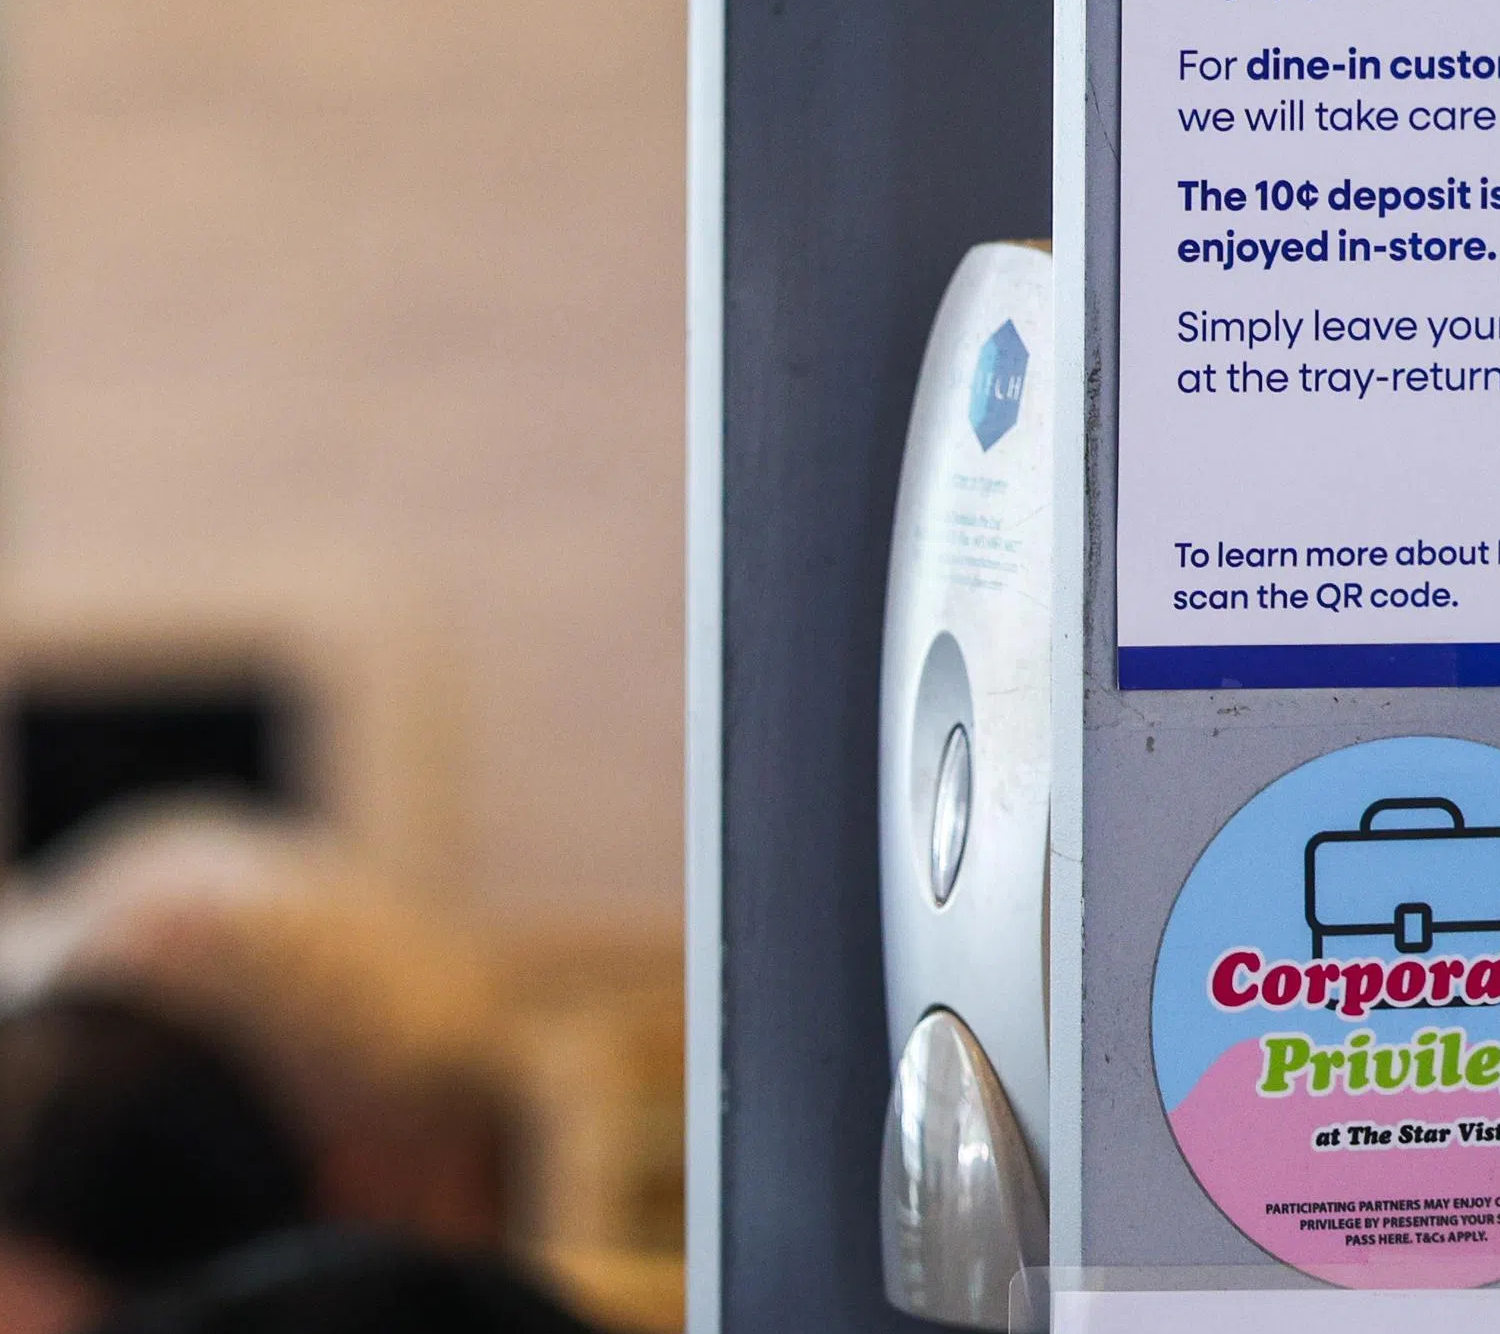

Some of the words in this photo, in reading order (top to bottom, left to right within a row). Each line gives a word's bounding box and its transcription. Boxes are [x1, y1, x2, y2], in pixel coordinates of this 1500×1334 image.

[1180, 50, 1237, 81] For
[1247, 47, 1380, 80] dine-in
[1178, 180, 1246, 211] The
[1255, 180, 1318, 211] 10¢
[1328, 177, 1471, 218] deposit
[1178, 229, 1328, 270] enjoyed
[1339, 229, 1496, 261] in-store.
[1175, 543, 1209, 568] To
[1218, 542, 1297, 568] learn
[1307, 547, 1388, 566] more
[1396, 539, 1489, 566] about
[1174, 590, 1248, 610] scan
[1257, 583, 1308, 609] the
[1316, 583, 1362, 612] QR
[1370, 581, 1458, 608] code.
[1316, 1129, 1340, 1146] at
[1348, 1126, 1391, 1145] The
[1399, 1125, 1450, 1143] Star
[1265, 1202, 1356, 1215] PARTICIPATING
[1359, 1199, 1421, 1212] PARTNERS
[1423, 1198, 1450, 1210] MAY
[1453, 1196, 1492, 1209] ENJOY
[1300, 1218, 1361, 1230] PRIVILEGE
[1365, 1217, 1380, 1229] BY
[1382, 1215, 1458, 1228] PRESENTING
[1461, 1213, 1496, 1225] YOUR
[1345, 1234, 1376, 1246] PASS
[1378, 1233, 1413, 1245] HERE.
[1415, 1232, 1445, 1244] T&Cs
[1447, 1231, 1488, 1243] APPLY.
